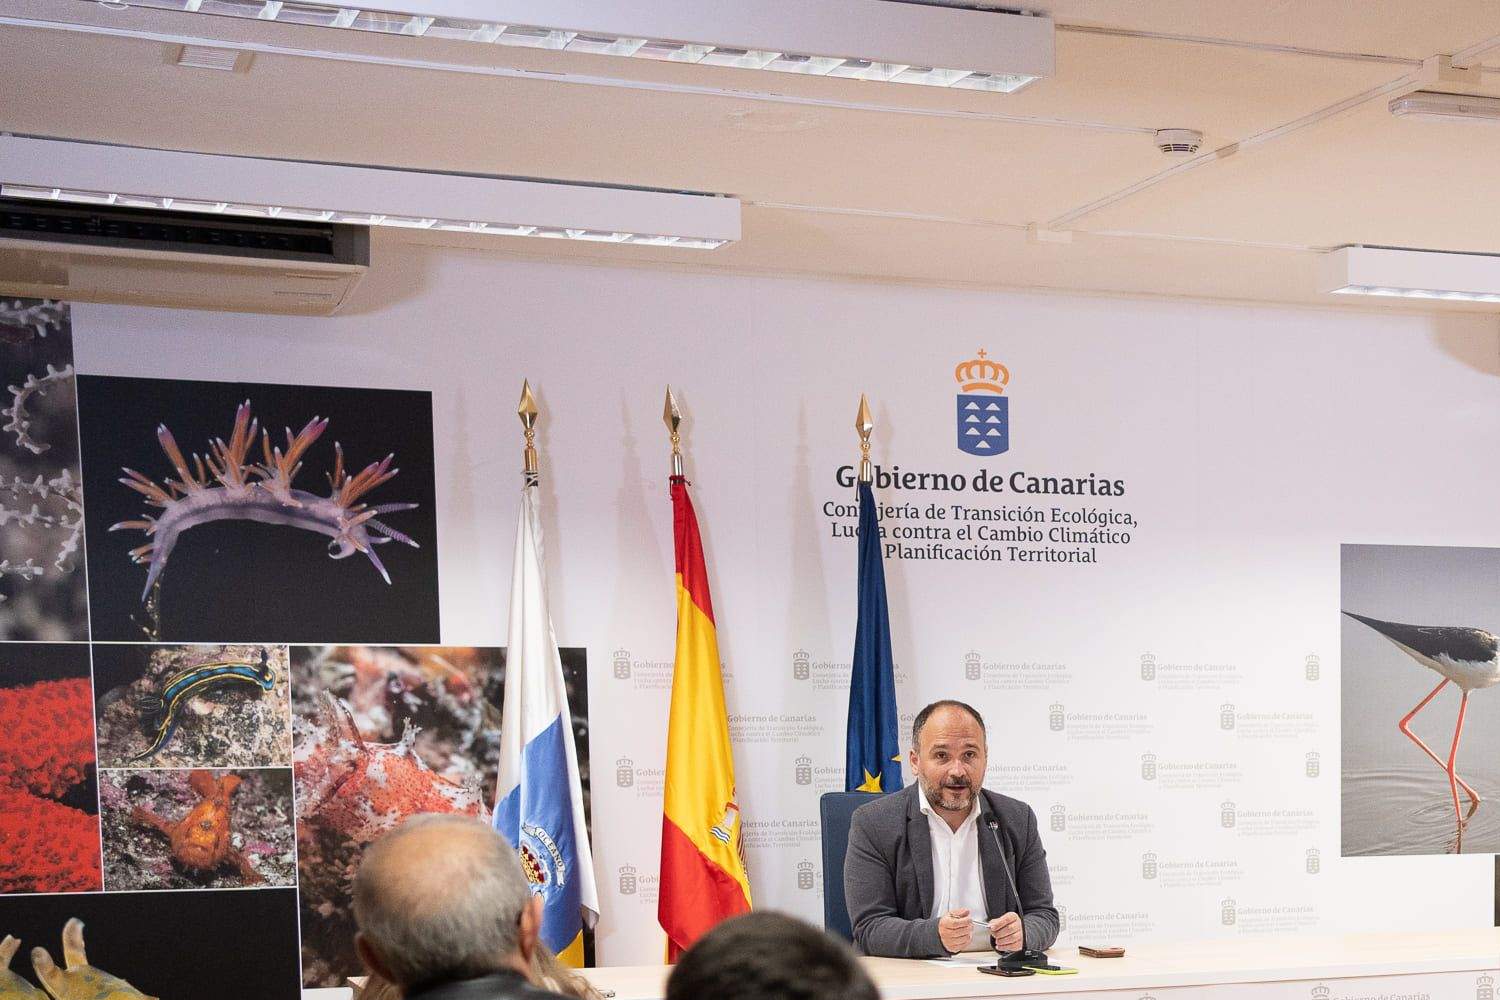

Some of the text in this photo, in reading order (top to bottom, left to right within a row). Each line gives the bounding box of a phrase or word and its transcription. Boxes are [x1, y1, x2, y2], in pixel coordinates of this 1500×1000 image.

[973, 470, 1003, 493] de
[1009, 473, 1125, 497] Canarias
[823, 502, 1138, 529] Conjería de Transición Ecológica,
[893, 527, 951, 541] contra
[957, 524, 972, 541] el
[978, 525, 1043, 543] Cambio
[1050, 527, 1131, 545] Climático
[885, 543, 1097, 563] Planificación Territorial
